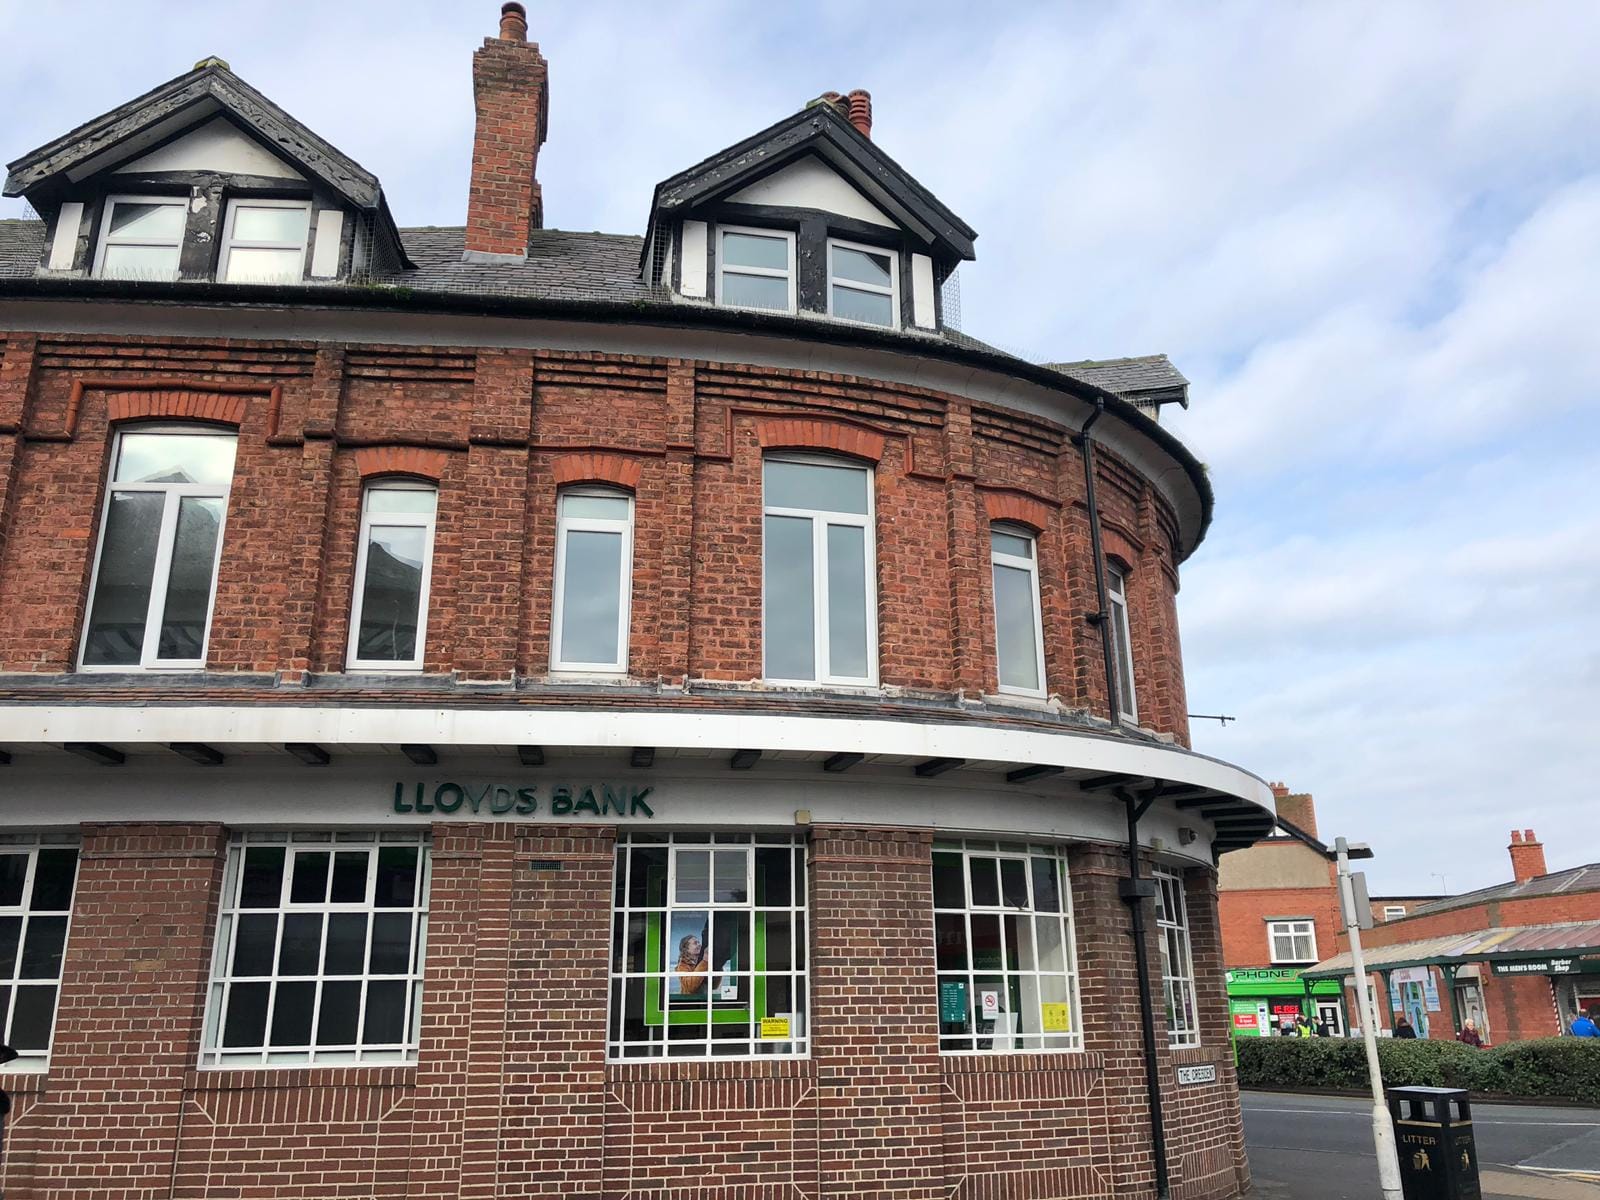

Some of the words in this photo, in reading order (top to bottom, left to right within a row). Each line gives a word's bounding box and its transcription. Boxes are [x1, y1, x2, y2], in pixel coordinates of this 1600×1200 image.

[394, 782, 538, 815] LLOYDS
[551, 783, 655, 818] BANK
[1236, 970, 1290, 978] PHONE
[1179, 1069, 1191, 1082] THE
[1402, 1134, 1436, 1145] LITTER
